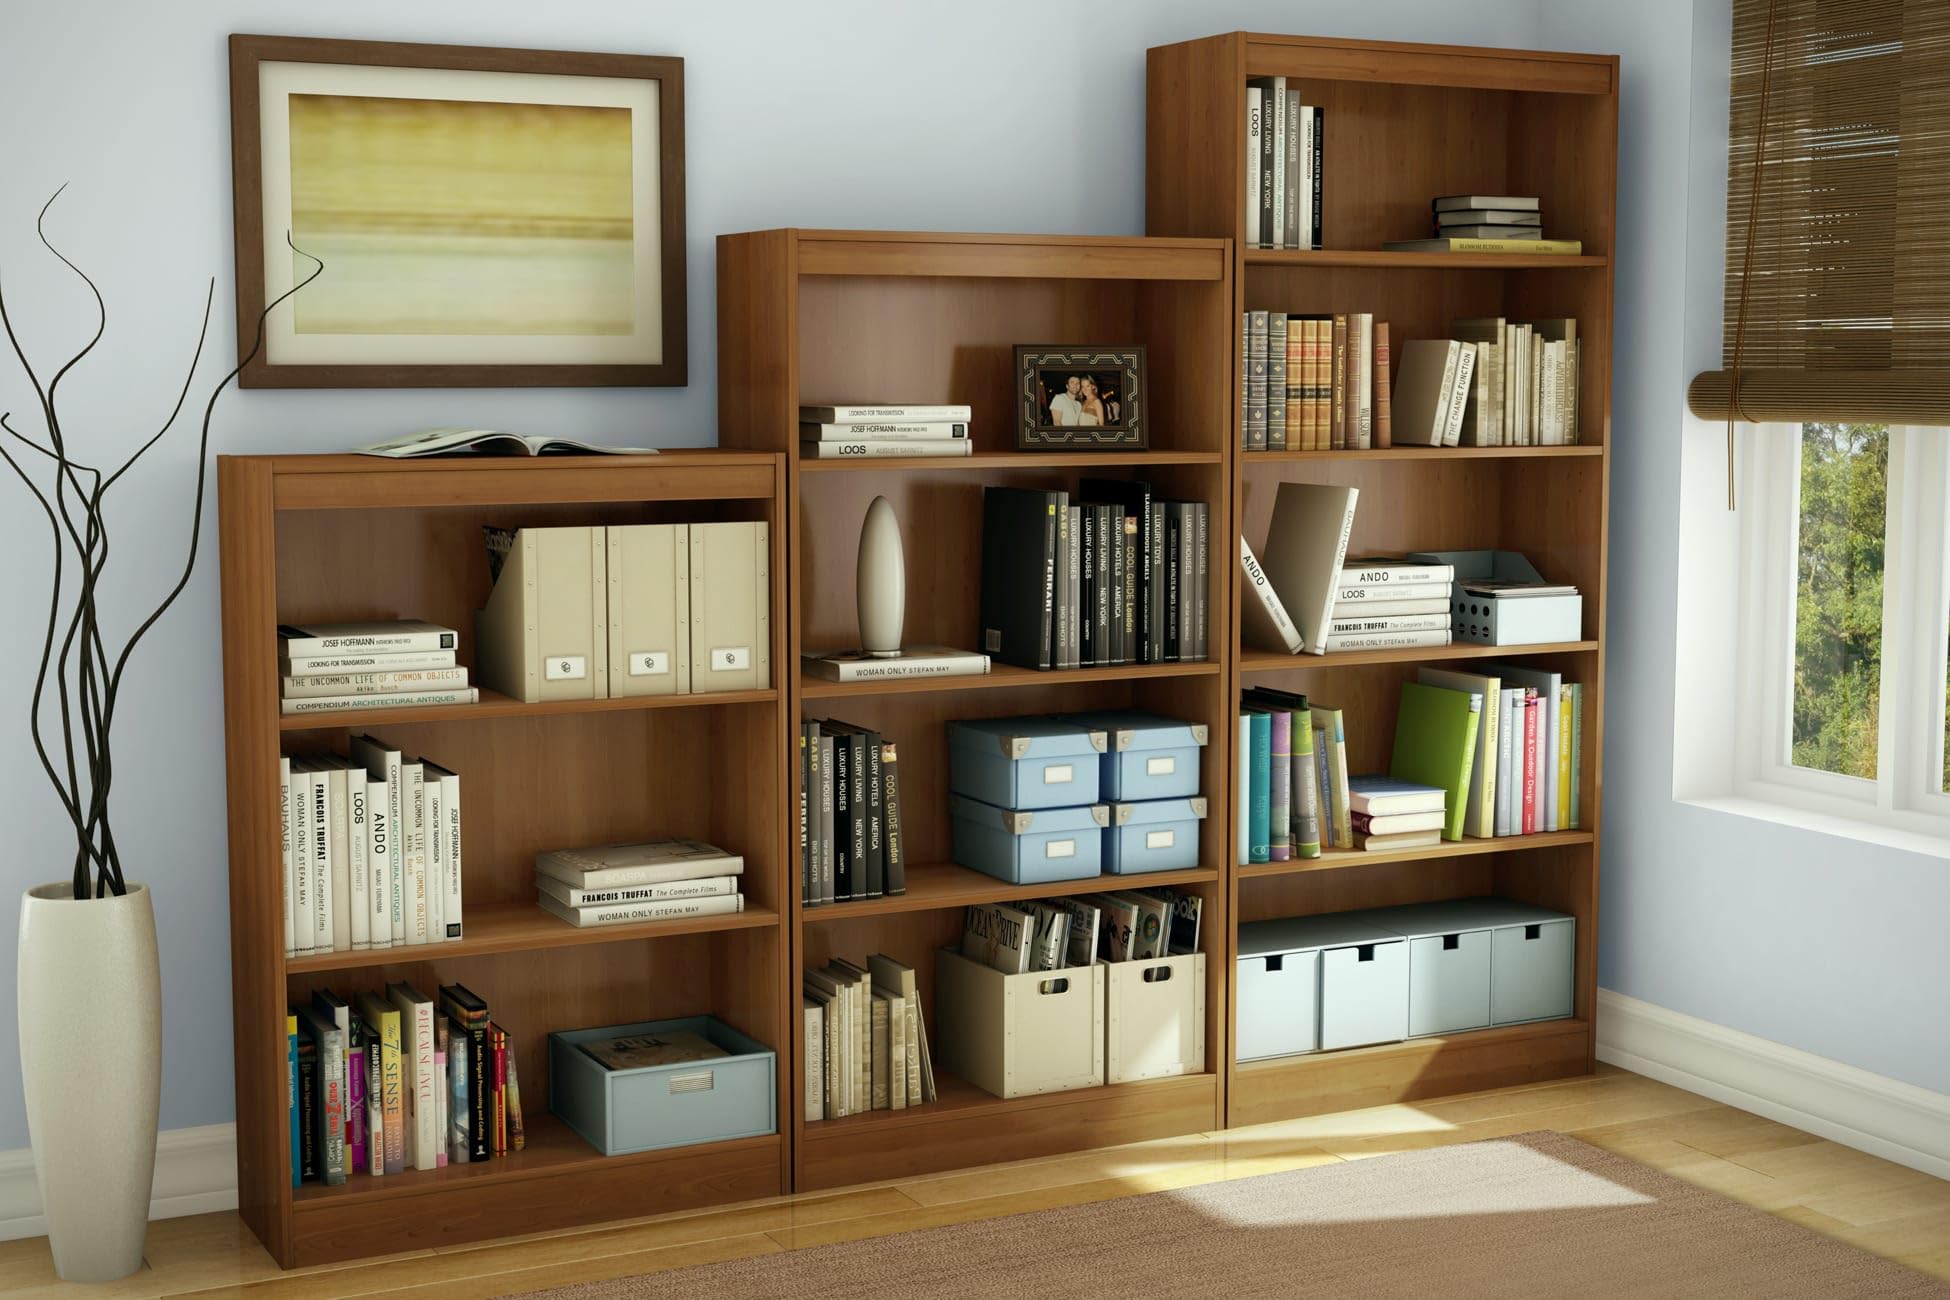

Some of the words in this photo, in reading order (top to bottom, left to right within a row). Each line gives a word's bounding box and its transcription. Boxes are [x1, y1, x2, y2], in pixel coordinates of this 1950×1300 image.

[1458, 353, 1471, 390] FUNCTION
[1556, 360, 1565, 423] PSYCHOTHERAPY
[1451, 392, 1464, 418] CHANGE
[1565, 384, 1575, 439] Parker
[1448, 419, 1457, 436] THE
[839, 445, 866, 454] LOOS
[1126, 546, 1134, 570] COOL
[1243, 555, 1264, 585] ANDO
[1126, 574, 1134, 599] GUIDE
[1360, 572, 1388, 582] ANDO
[1342, 590, 1365, 599] LOOS
[1126, 603, 1134, 633] London
[1334, 623, 1362, 631] FRANCOIS
[322, 639, 340, 648] JOSEF
[340, 638, 375, 646] HOFFMANN
[291, 678, 305, 687] THE
[311, 677, 350, 686] UNCOMMON
[355, 675, 374, 684] LIFE
[394, 672, 422, 681] COMMON
[427, 671, 460, 680] OBJECTS
[856, 668, 885, 676] WOMAN
[888, 667, 907, 675] ONLY
[296, 700, 350, 710] COMPENDIUM
[352, 697, 415, 707] ARCHITECTURAL
[417, 695, 455, 704] ANTIQUES
[885, 775, 896, 799] COOL
[1526, 780, 1534, 804] Design
[316, 784, 324, 823] FRANCOIS
[353, 792, 364, 824] LOOS
[414, 790, 423, 827] UNCOMMON
[281, 785, 290, 851] BAUHAUS
[888, 802, 898, 830] GUIDE
[316, 826, 326, 860] TRUFFAT
[374, 813, 386, 854] ANDO
[416, 833, 424, 851] LIFE
[452, 826, 460, 860] HOFFMANN
[416, 855, 423, 864] OF
[889, 832, 899, 863] London
[582, 892, 618, 903] FRANCOIS
[622, 890, 653, 900] TRUFFAT
[669, 887, 699, 896] Complete
[701, 885, 717, 894] Films
[416, 904, 425, 937] OBJECTS
[598, 911, 629, 921] WOMAN
[632, 910, 653, 918] ONLY
[655, 907, 683, 916] STEFAN
[966, 904, 991, 939] OCEAN
[388, 1024, 396, 1038] The
[418, 1018, 431, 1066] BECAUSE
[384, 1039, 399, 1058] 7th
[476, 1045, 485, 1061] Audio
[476, 1061, 485, 1079] Signal
[386, 1063, 398, 1114] SENSE
[476, 1080, 484, 1109] Processing
[476, 1121, 485, 1140] Coding
[394, 1149, 401, 1160] TO
